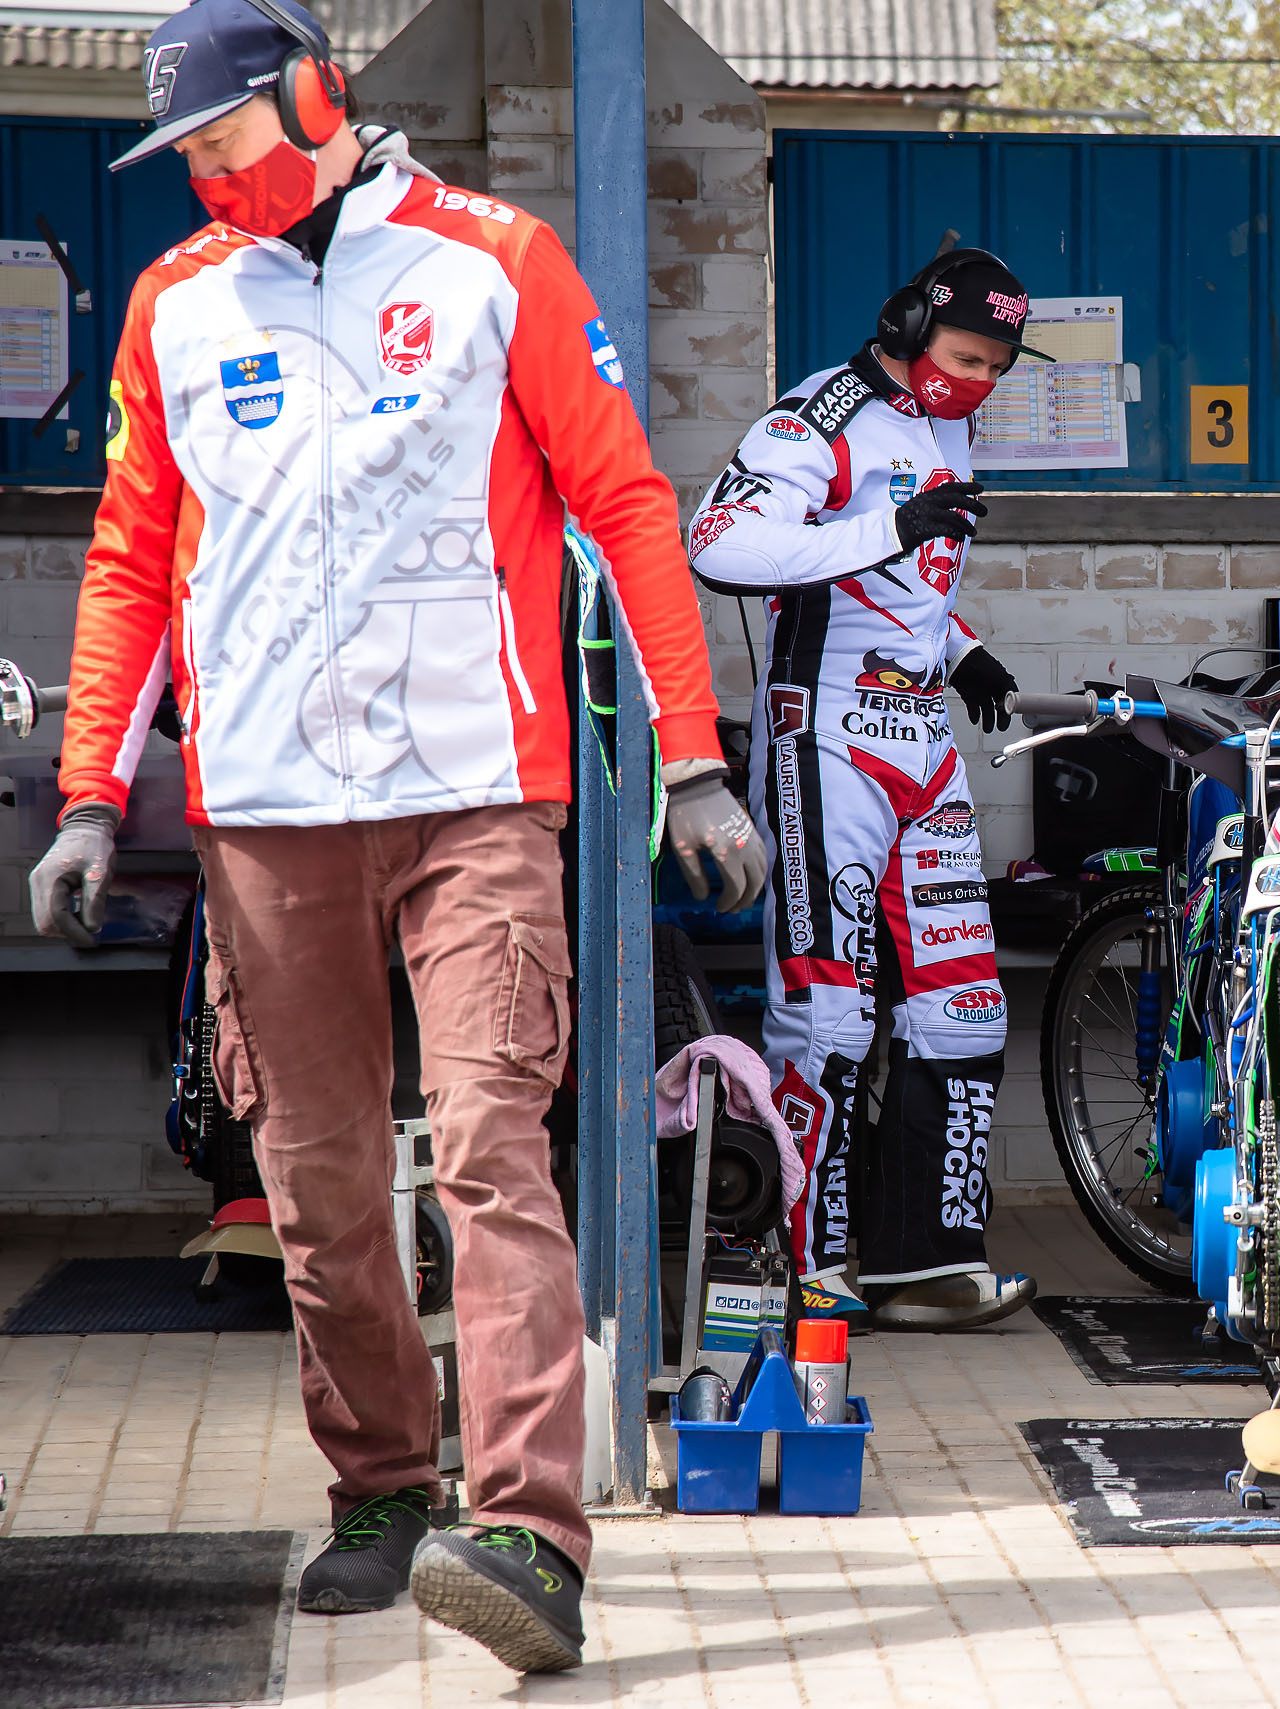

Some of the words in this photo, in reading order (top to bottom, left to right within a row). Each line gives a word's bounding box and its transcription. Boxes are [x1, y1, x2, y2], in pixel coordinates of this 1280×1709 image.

[432, 187, 516, 225] 1963
[992, 306, 1018, 327] LIFTS
[811, 373, 863, 424] HAGON
[822, 382, 873, 432] SHOCKS
[770, 428, 804, 441] PRODUCTS
[1207, 399, 1234, 448] 3
[706, 519, 733, 545] PLUGS
[842, 712, 918, 742] Colin
[779, 742, 797, 809] LAURITZ
[783, 812, 804, 900] ANDERSEN
[791, 904, 805, 915] &
[918, 890, 953, 901] Claus
[955, 887, 977, 899] Ørts
[793, 917, 809, 947] CO.
[956, 1004, 1002, 1020] PRODUCTS
[941, 1078, 966, 1229] SHOCKS
[962, 1079, 995, 1231] HAGON
